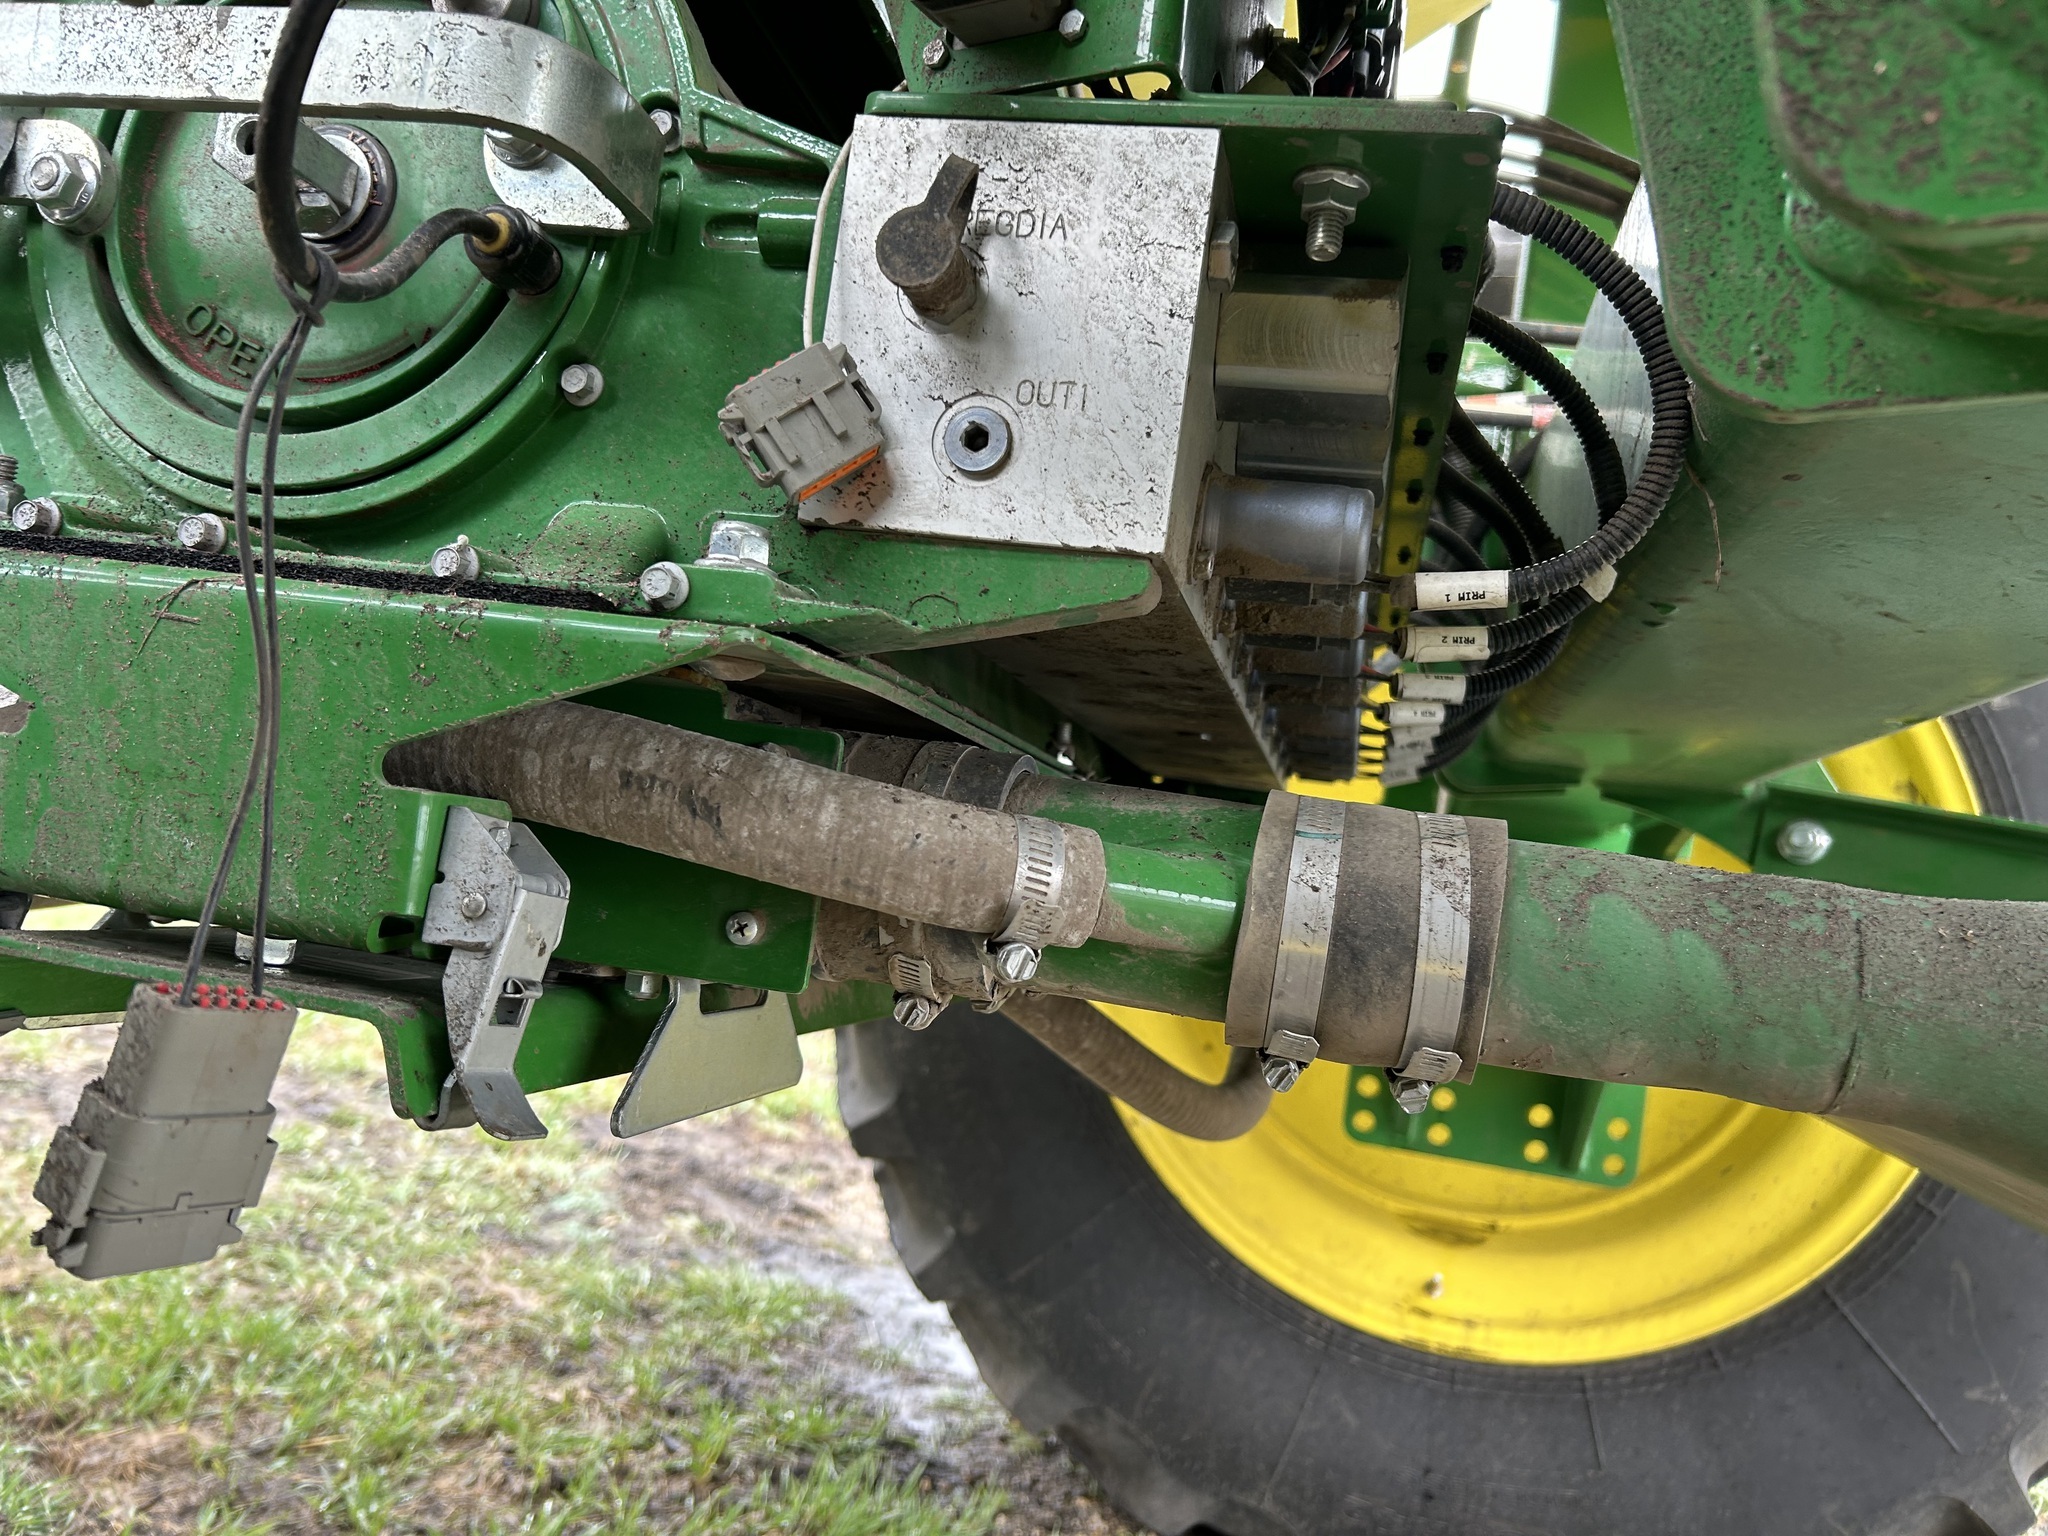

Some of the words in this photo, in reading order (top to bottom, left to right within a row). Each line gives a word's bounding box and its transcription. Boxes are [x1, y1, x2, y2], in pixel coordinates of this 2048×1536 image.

[1444, 593, 1451, 603] 1
[1458, 591, 1486, 602] PRIM
[1441, 635, 1448, 644] 2
[1452, 635, 1476, 645] PRIM
